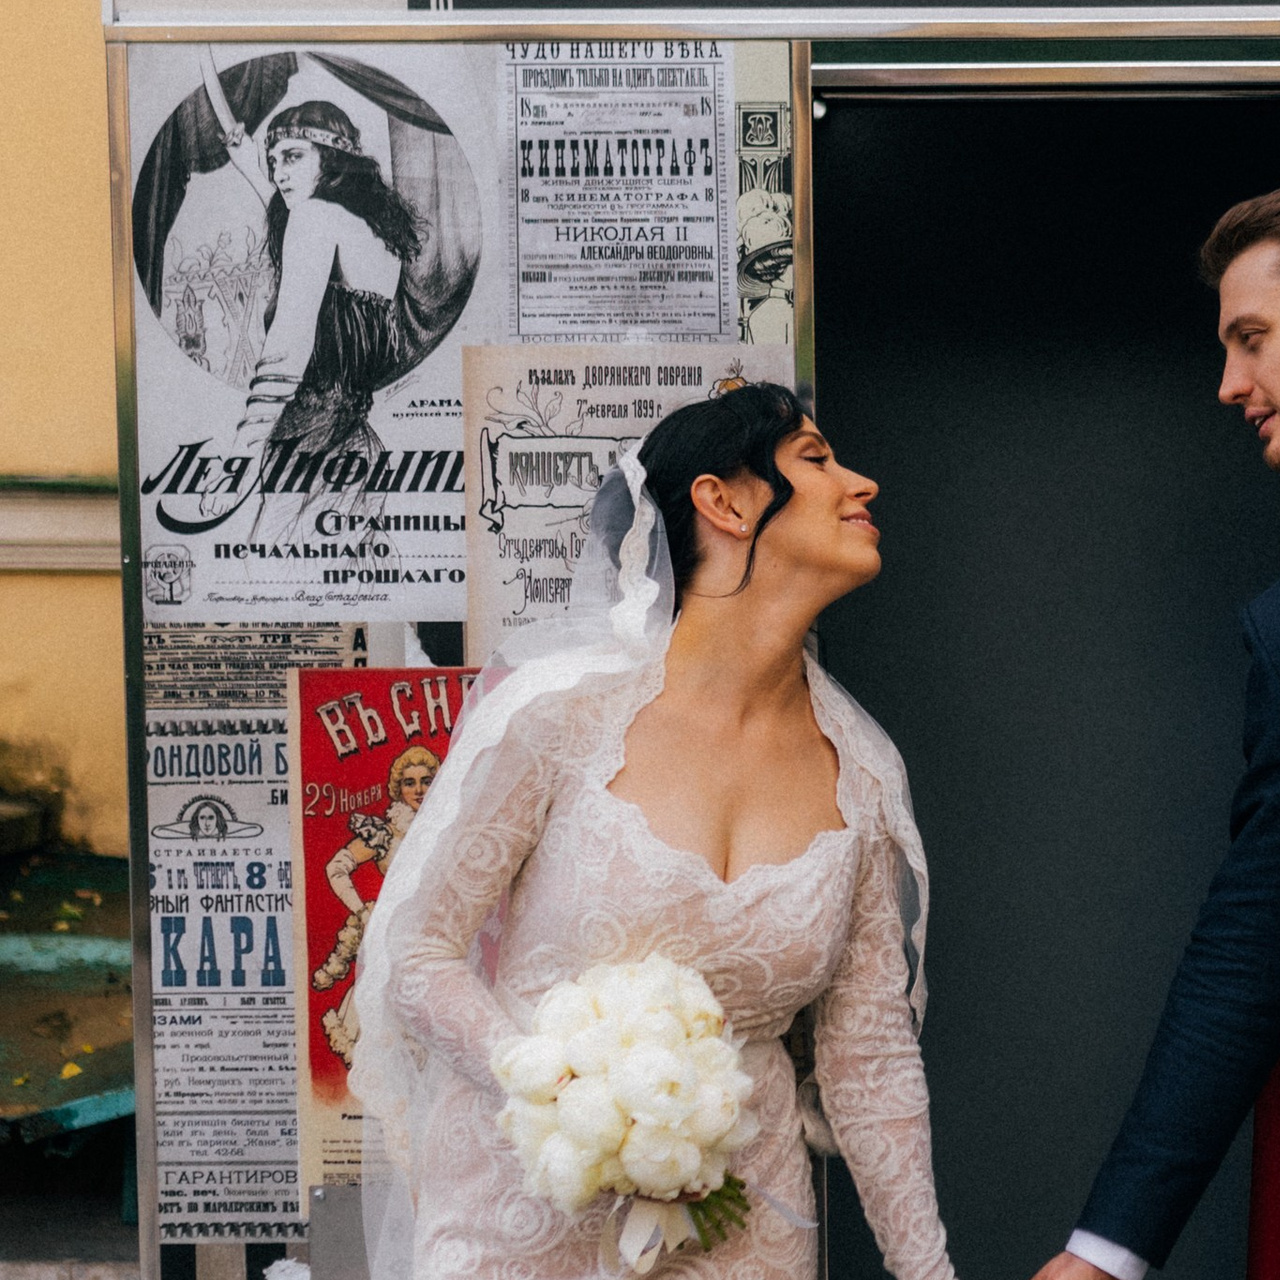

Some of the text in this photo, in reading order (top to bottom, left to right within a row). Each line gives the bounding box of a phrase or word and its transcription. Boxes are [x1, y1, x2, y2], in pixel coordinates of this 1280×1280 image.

[505, 41, 561, 60] ЧУДО
[569, 41, 655, 60] НАШЕГО
[520, 138, 713, 178] КИНЕМАТОГРАФЪ
[520, 187, 714, 203] 18 КИНЕМАТОГРАФА 18
[555, 226, 665, 242] НИКОЛАЯ
[632, 398, 655, 419] 1899
[316, 691, 389, 762] ВЪ
[147, 738, 262, 778] ОНДОВОЙ
[304, 782, 336, 817] 29
[160, 915, 286, 988] КАРА
[164, 1169, 298, 1186] ГАРАНТИРОВ
